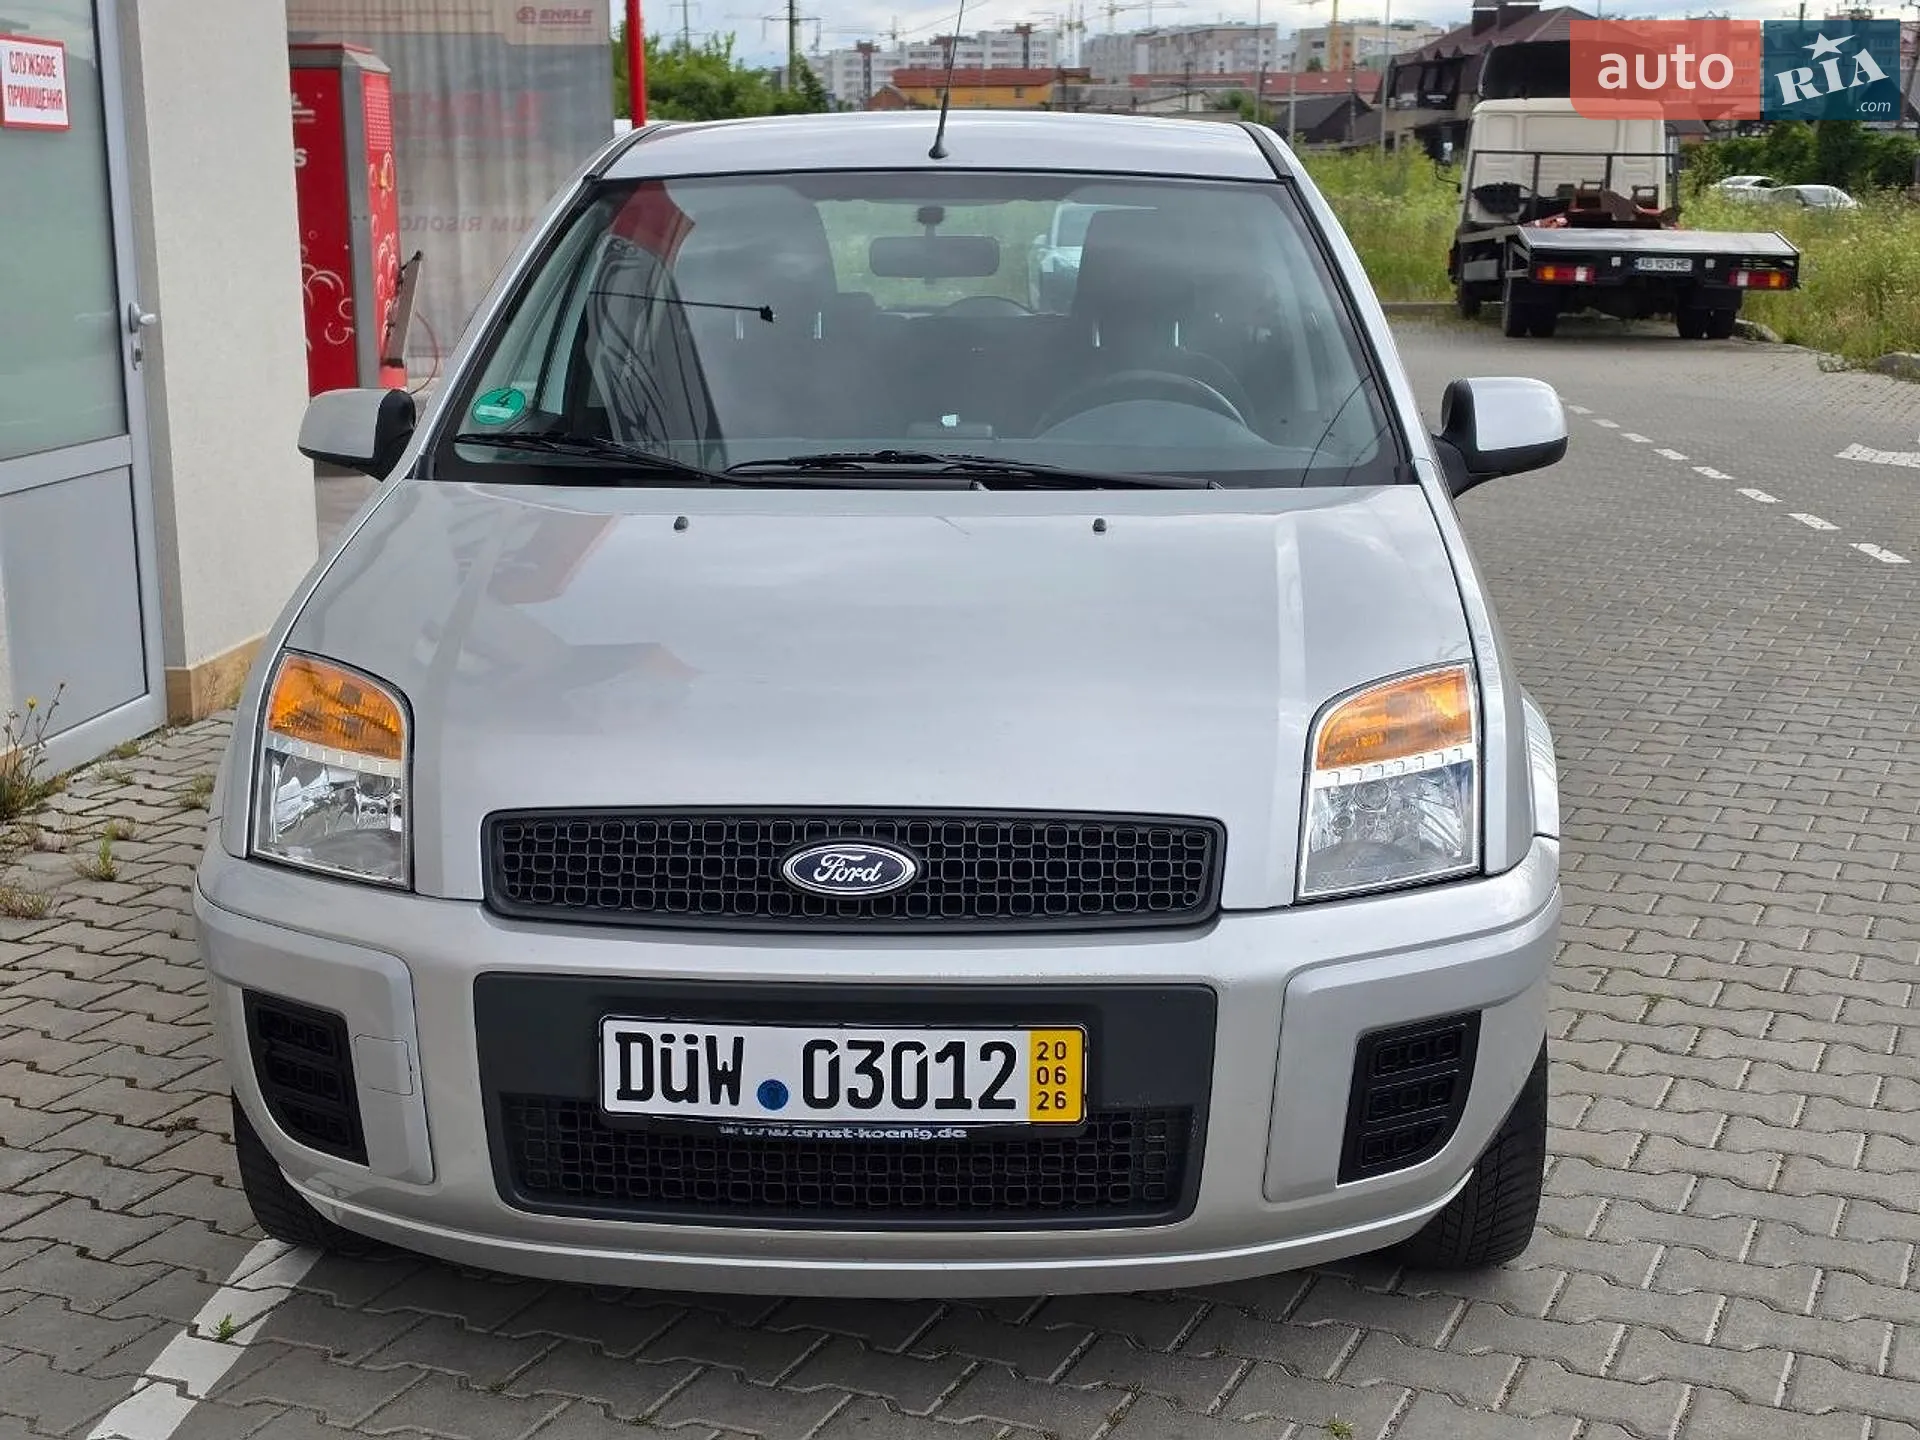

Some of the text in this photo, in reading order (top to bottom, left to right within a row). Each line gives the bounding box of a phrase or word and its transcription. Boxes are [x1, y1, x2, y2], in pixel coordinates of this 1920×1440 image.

[9, 51, 57, 78] СЛУЖБОВЕ
[8, 84, 63, 111] ПРИМІЩЕННЯ
[495, 389, 512, 407] 4
[813, 853, 884, 882] Ford
[1036, 1041, 1067, 1061] 20
[803, 1039, 1017, 1110] 03012
[1036, 1066, 1067, 1085] 06
[1036, 1091, 1067, 1110] 26
[719, 1125, 968, 1140] www.ernst-koenig.de
